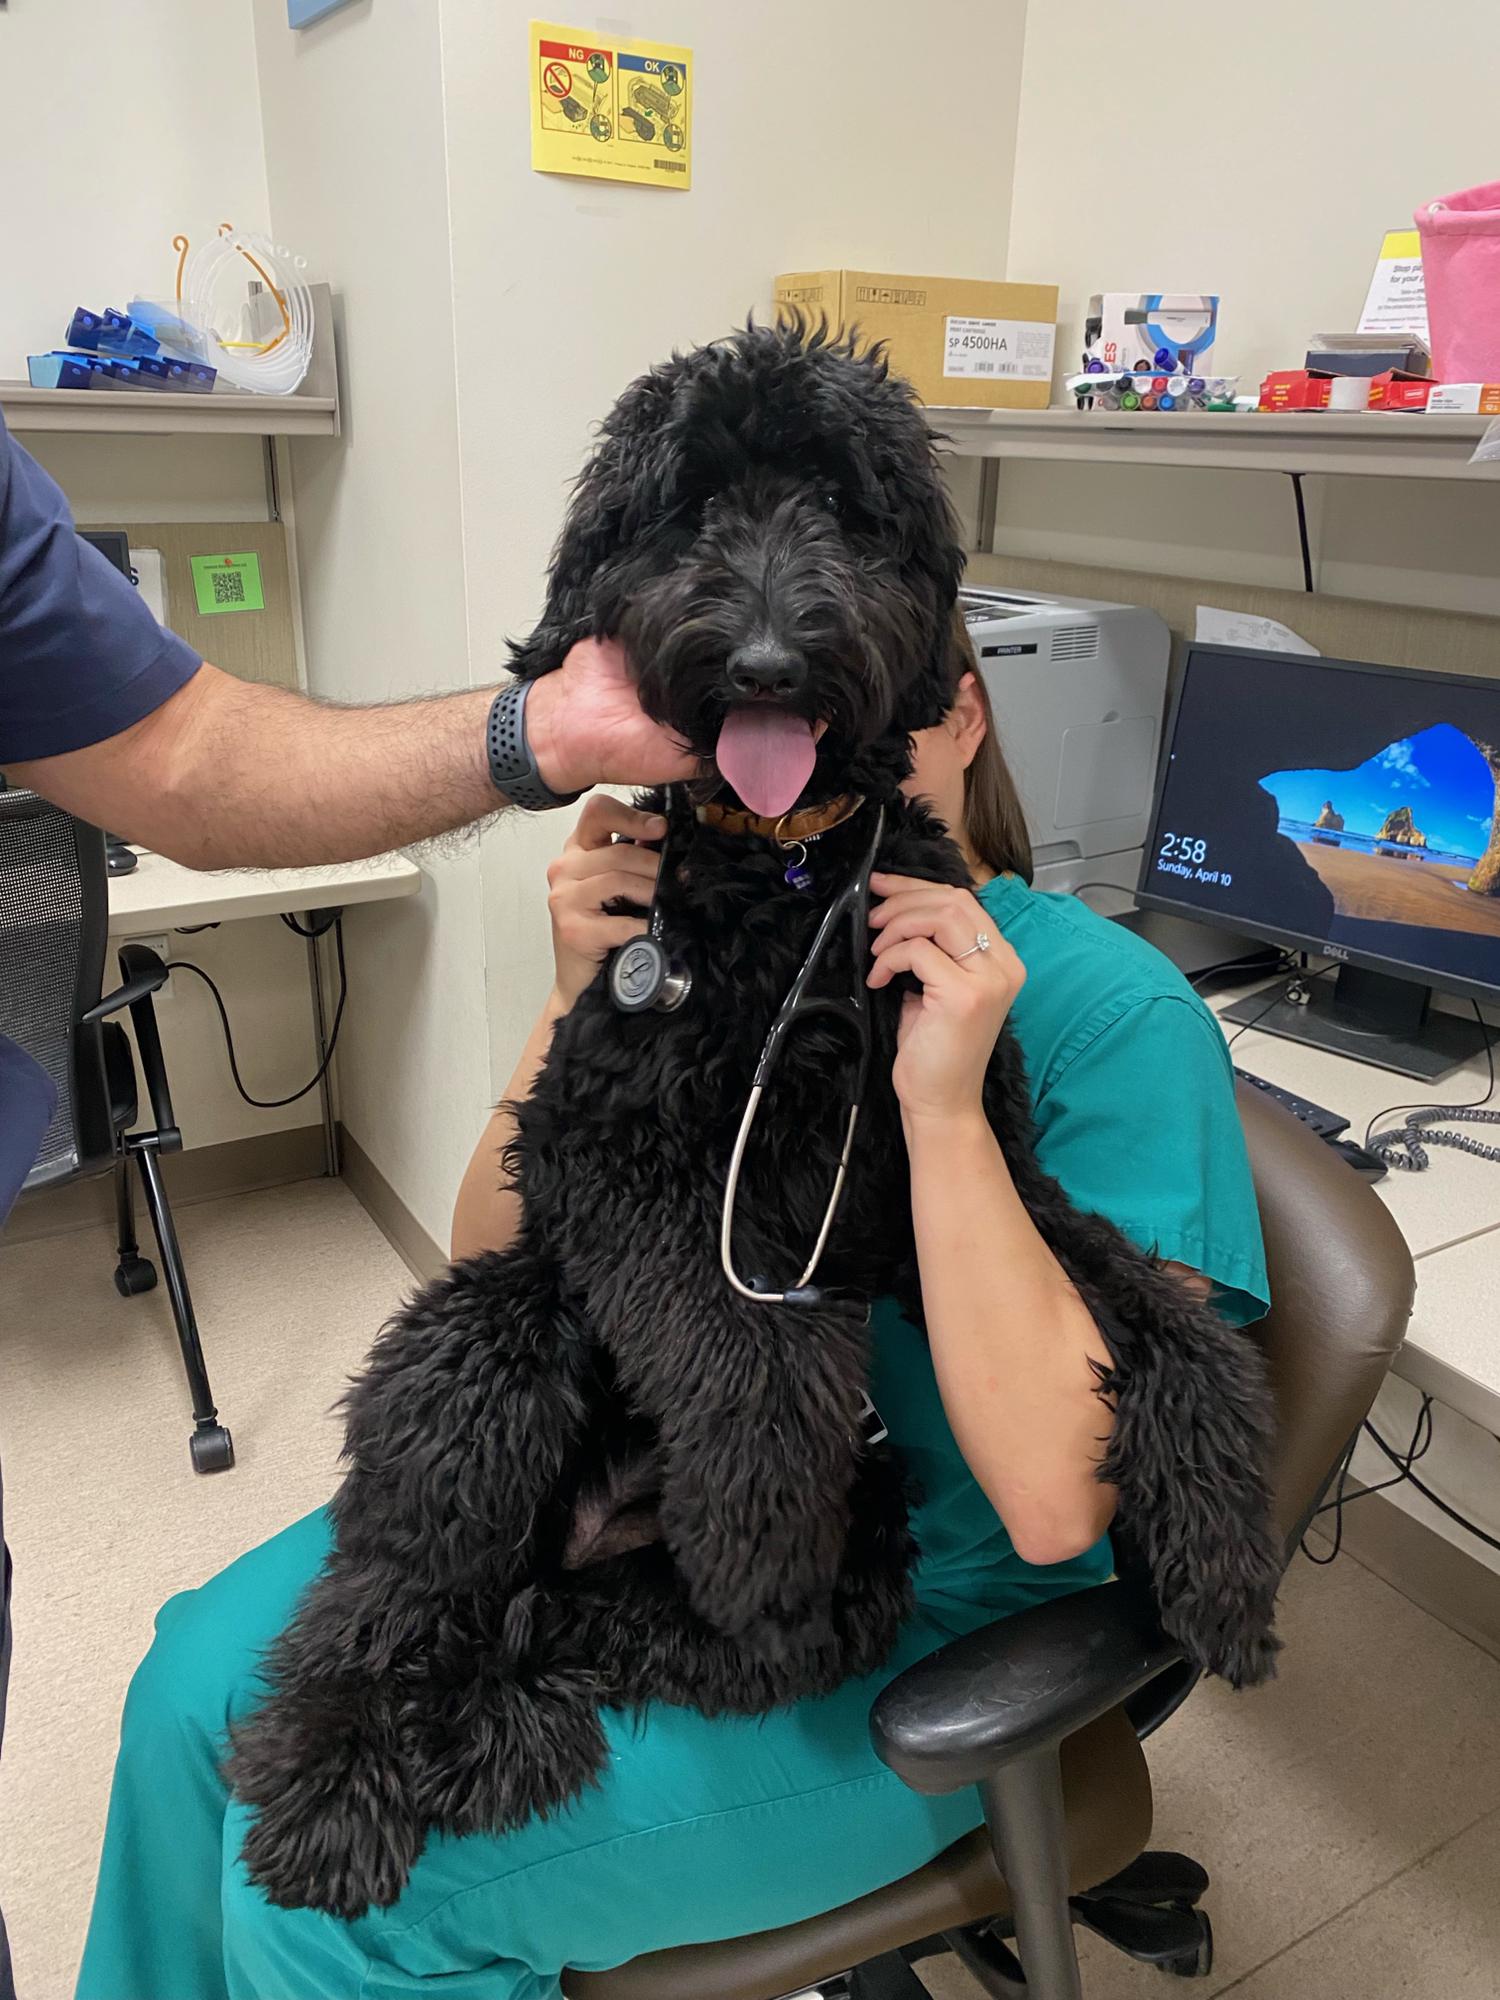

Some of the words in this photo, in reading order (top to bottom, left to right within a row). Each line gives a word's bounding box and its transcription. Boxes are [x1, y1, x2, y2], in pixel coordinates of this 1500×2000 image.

[568, 48, 584, 60] NG
[644, 60, 660, 73] OK
[1390, 275, 1401, 283] for
[1401, 275, 1419, 284] your
[948, 337, 960, 348] SP
[962, 336, 1008, 351] 4500HA
[997, 646, 1022, 655] PRINTER
[1160, 833, 1206, 863] 2:58
[1157, 858, 1193, 879] Sunday,
[1194, 867, 1219, 883] April
[1220, 873, 1232, 887] 10
[1323, 944, 1349, 960] DELL
